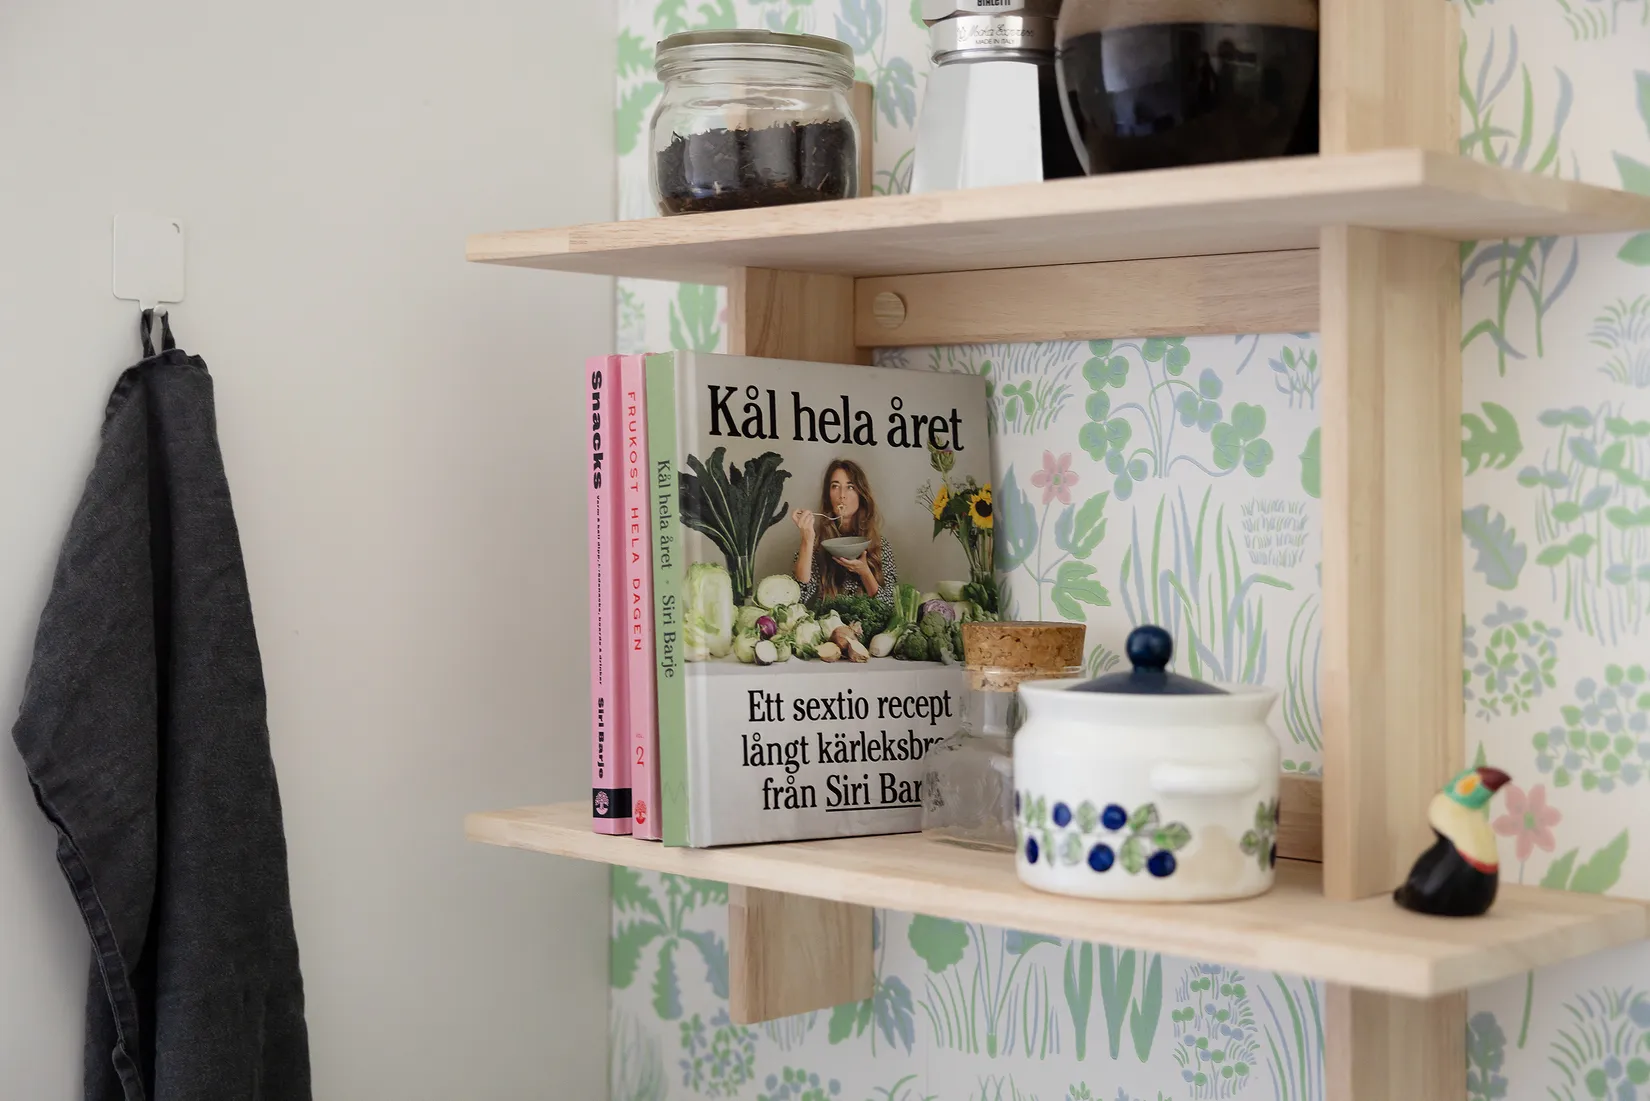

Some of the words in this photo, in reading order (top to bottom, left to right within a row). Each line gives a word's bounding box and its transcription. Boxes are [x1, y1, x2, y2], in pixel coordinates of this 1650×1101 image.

[591, 370, 604, 490] Snacks
[707, 384, 780, 440] Kål
[791, 391, 878, 447] hela
[887, 396, 965, 451] året
[628, 391, 639, 492] FRUKOST
[657, 459, 672, 489] Kål
[658, 494, 673, 530] hela
[630, 507, 640, 564] HELA
[660, 535, 674, 570] året
[632, 578, 642, 651] DAGEN
[661, 594, 676, 626] Siri
[661, 631, 677, 678] Barje
[747, 689, 785, 722] Ett
[792, 688, 869, 721] sextio
[877, 689, 953, 726] recept
[597, 731, 605, 779] Barje
[636, 745, 645, 767] 2
[741, 732, 811, 774] långt
[817, 729, 945, 764] kärleksbr
[762, 775, 818, 811] från
[826, 773, 871, 808] Siri
[879, 772, 923, 804] Bar
